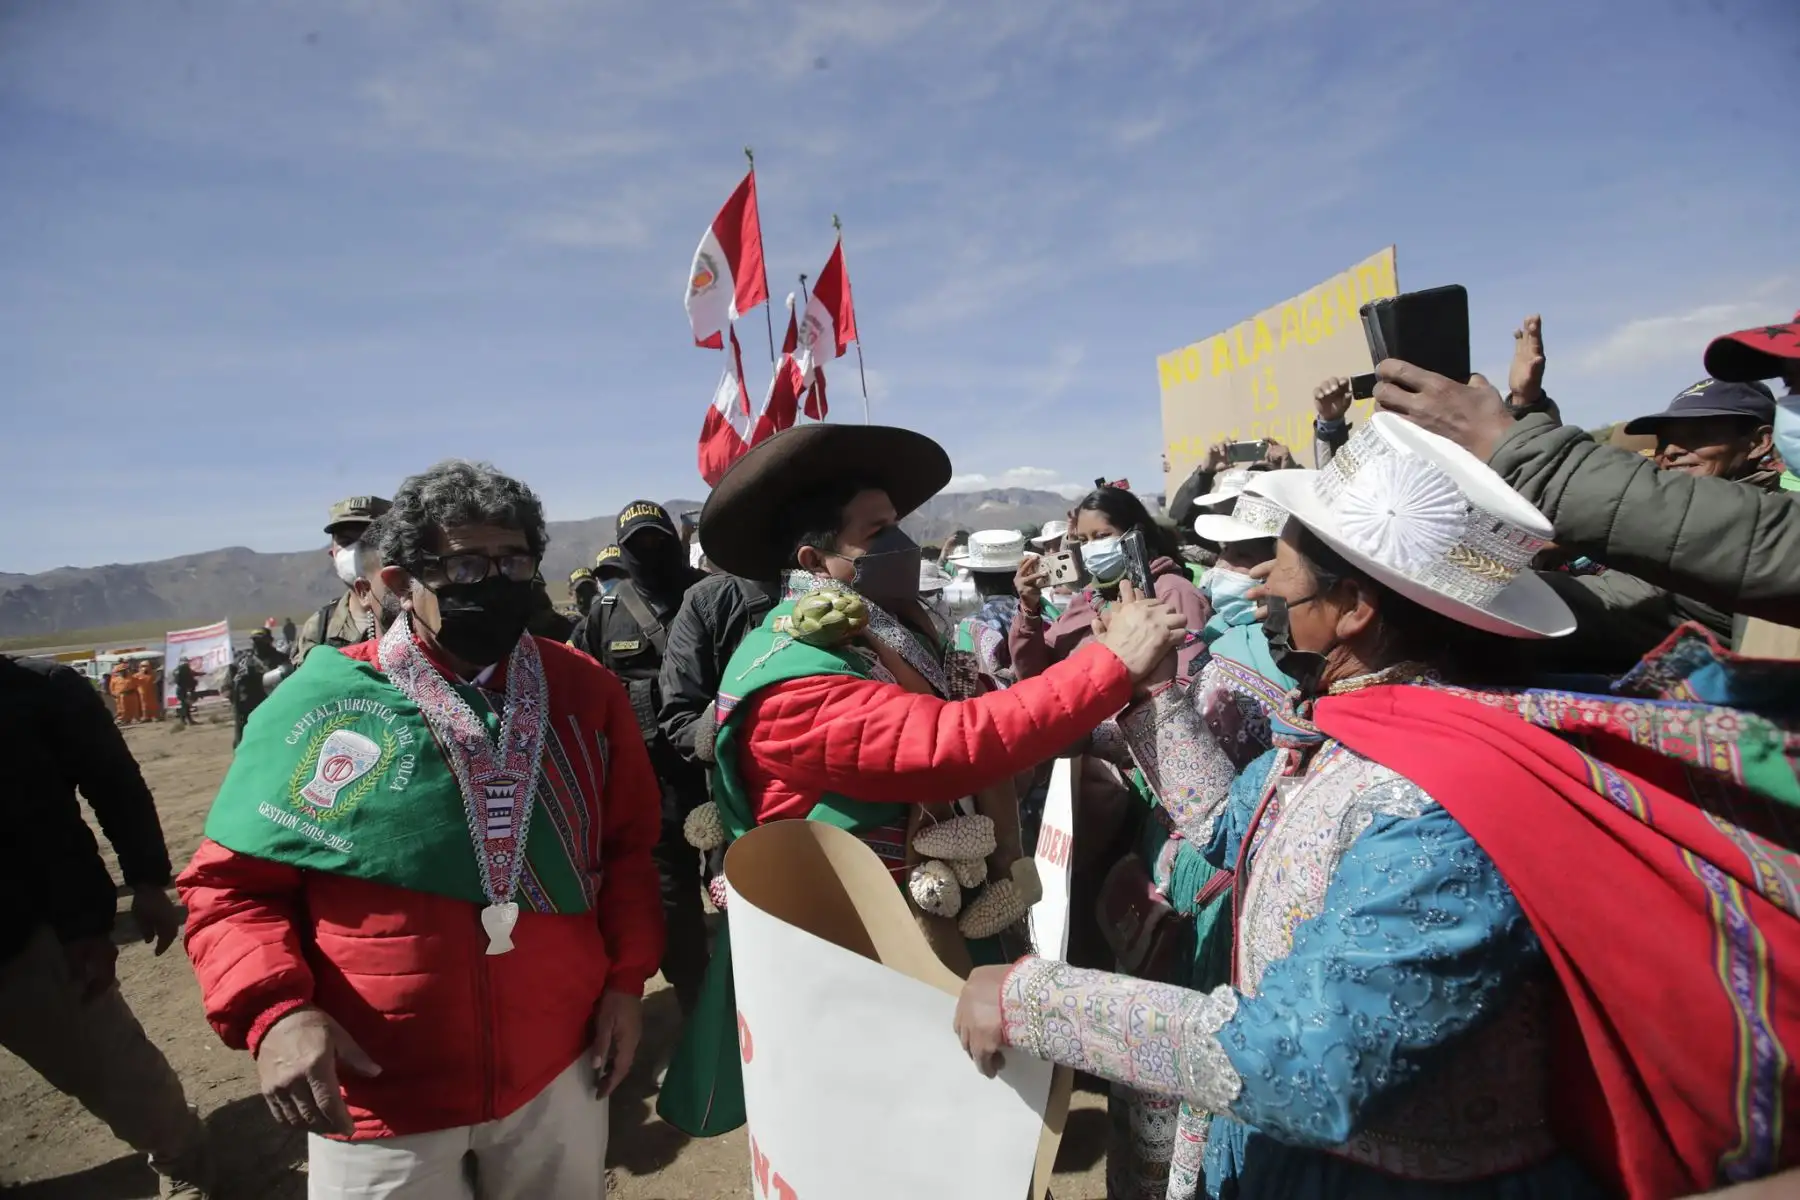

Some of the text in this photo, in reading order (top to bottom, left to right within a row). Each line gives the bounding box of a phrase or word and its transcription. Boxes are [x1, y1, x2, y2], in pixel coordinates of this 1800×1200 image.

[1160, 347, 1200, 391] NO
[620, 504, 664, 528] POLICIA
[285, 704, 334, 745] CAPITAL
[394, 724, 414, 749] DEL
[389, 753, 415, 791] COLCA
[258, 800, 354, 853] GESTION 2019-2022
